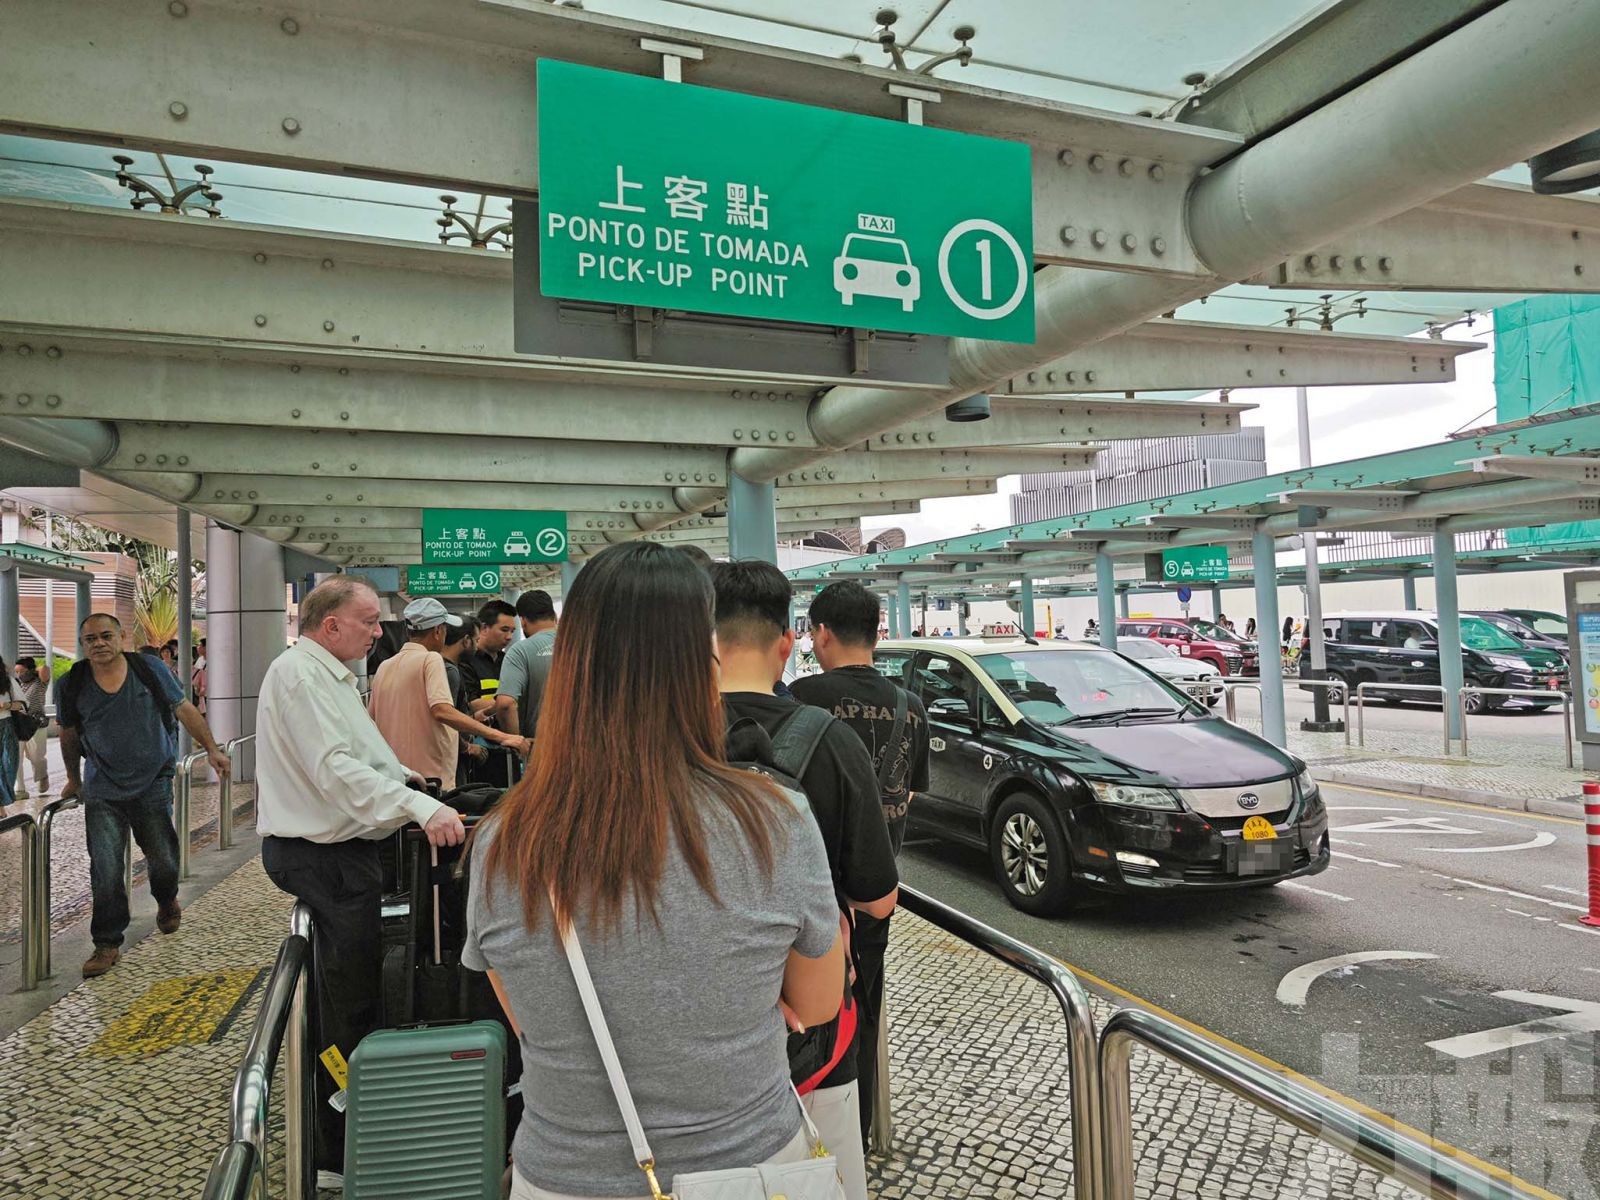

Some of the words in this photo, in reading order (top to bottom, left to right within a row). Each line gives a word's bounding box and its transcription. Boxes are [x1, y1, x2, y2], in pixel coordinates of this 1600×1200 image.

[599, 166, 769, 230] 上客點
[860, 215, 894, 232] TAXI
[549, 213, 645, 248] PONTO
[655, 226, 689, 254] DE
[701, 232, 809, 268] TOMADA
[579, 253, 693, 288] PICK-UP
[712, 267, 788, 298] POINT
[976, 239, 992, 301] 1
[438, 527, 486, 540] 上客點
[425, 541, 451, 549] PONTO
[453, 541, 464, 549] DE
[466, 541, 497, 549] TOMADA
[544, 532, 558, 551] 2
[433, 550, 465, 558] PICK-UP
[468, 550, 491, 558] POINT
[990, 624, 1014, 635] TAXI
[1241, 796, 1257, 804] BYD
[1246, 819, 1268, 831] TAXI
